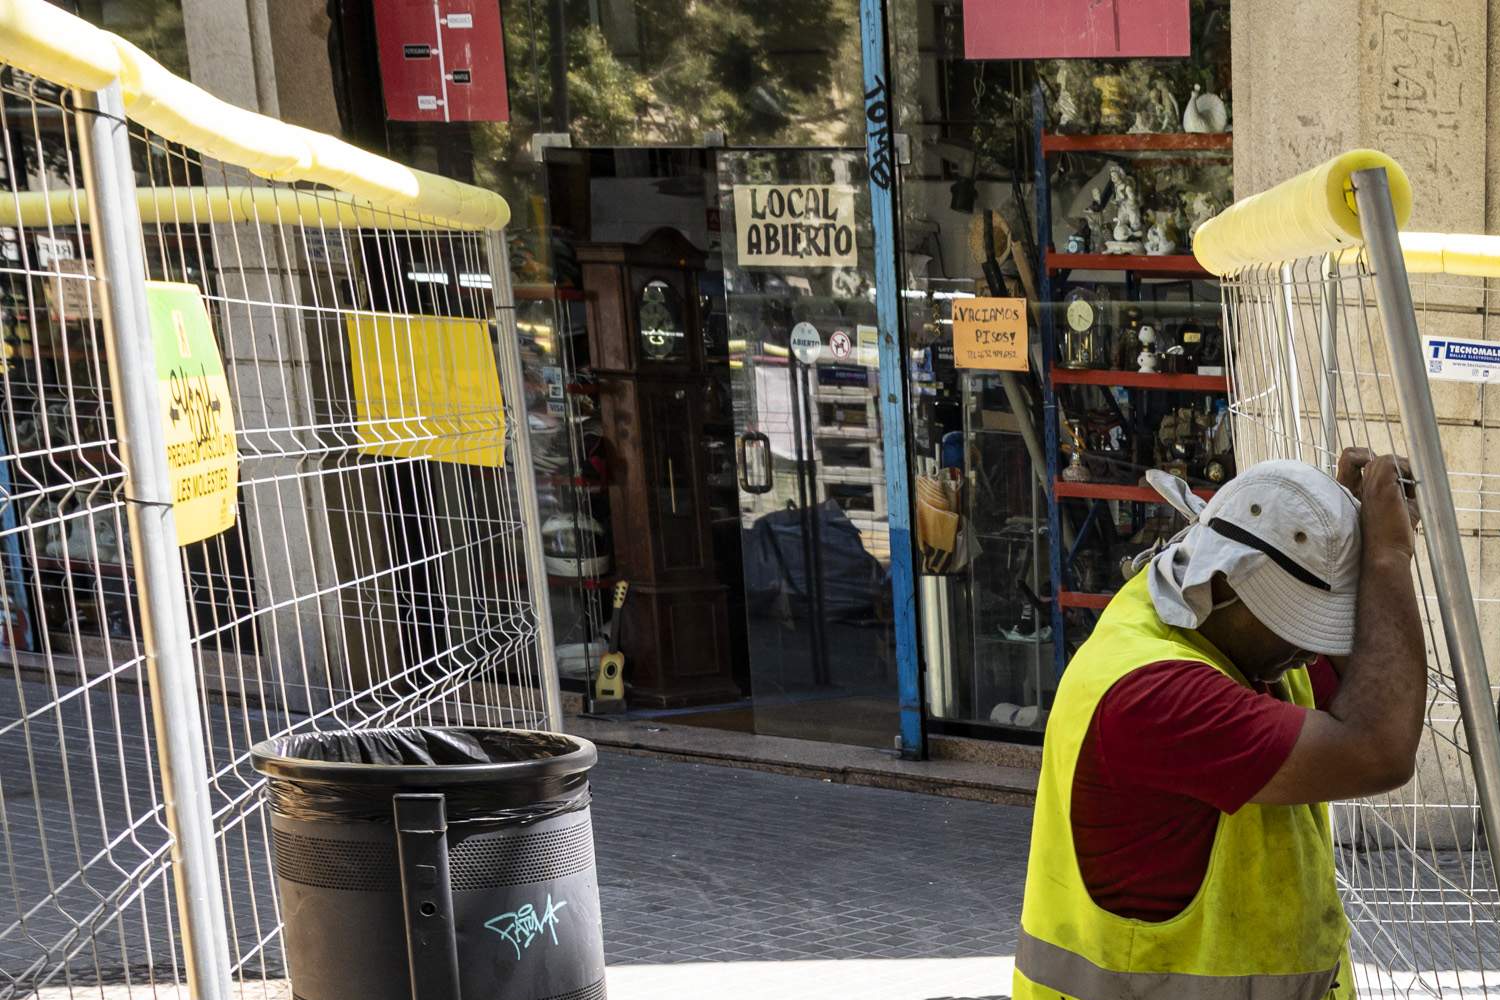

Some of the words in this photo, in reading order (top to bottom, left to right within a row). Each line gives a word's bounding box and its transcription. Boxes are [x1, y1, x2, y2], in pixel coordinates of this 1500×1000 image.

[750, 188, 838, 221] LOCAL
[747, 223, 852, 258] ABIERTO
[975, 329, 1017, 346] PISOS!
[177, 477, 191, 503] LES
